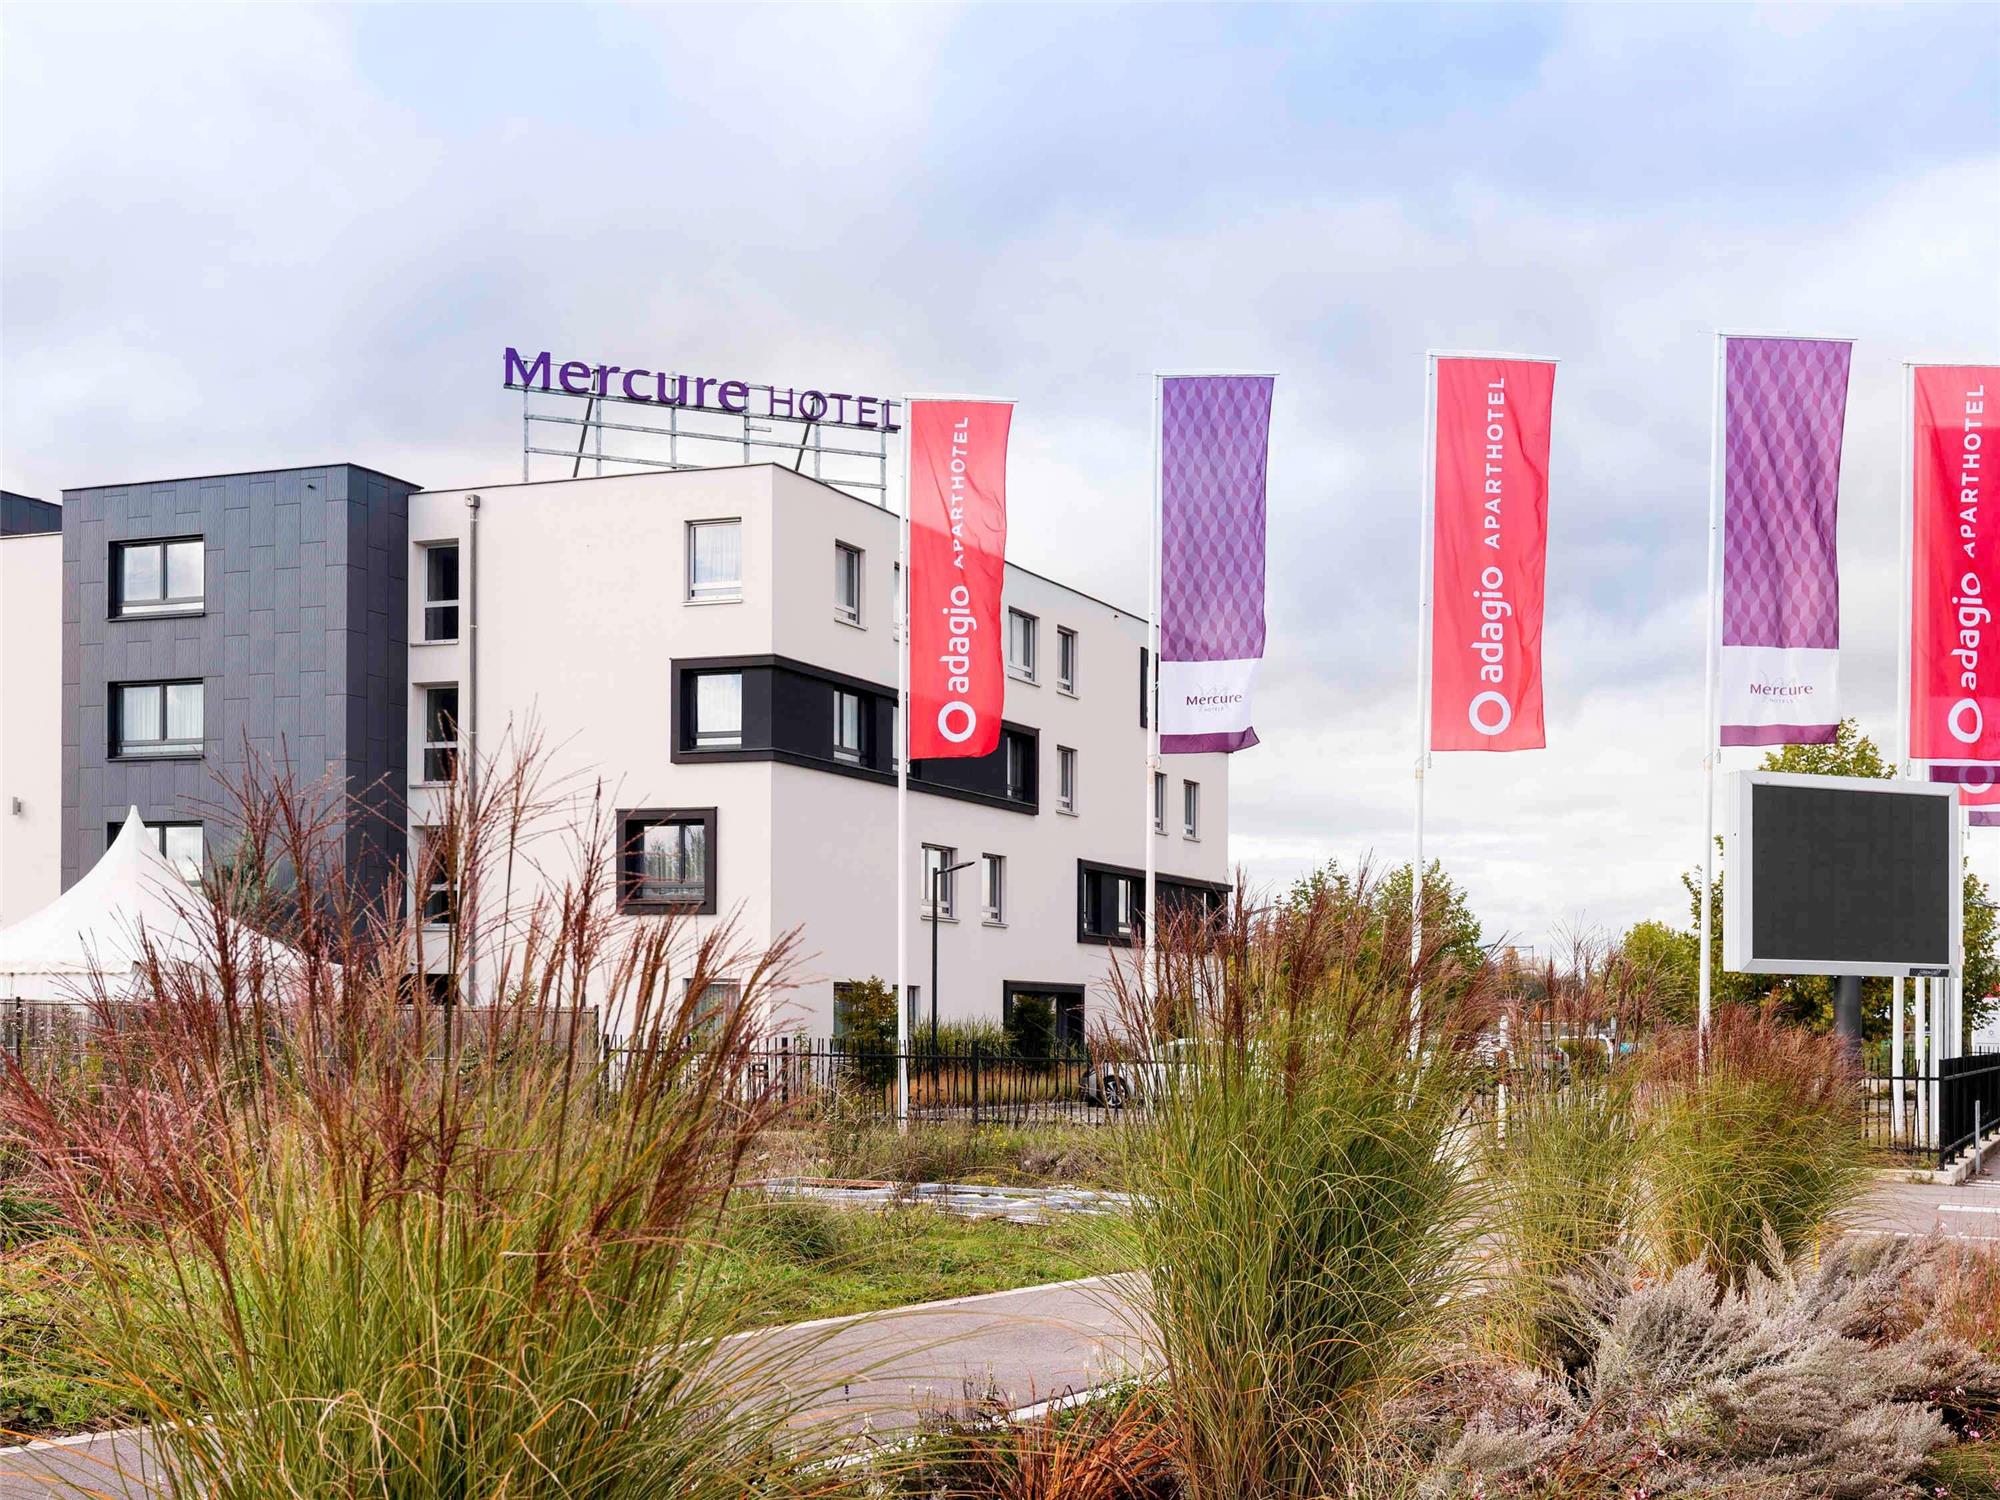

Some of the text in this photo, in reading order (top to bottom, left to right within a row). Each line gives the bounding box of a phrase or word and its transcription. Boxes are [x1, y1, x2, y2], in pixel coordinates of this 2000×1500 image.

[505, 347, 901, 430] Mercure HOTEL
[939, 416, 977, 693] adagio APARTHOTEL
[1471, 377, 1512, 683] adagio APARTHOTEL
[1950, 384, 1991, 690] adagio APARTHOTEL
[1186, 694, 1242, 705] Mercure
[1750, 683, 1813, 696] Mercure
